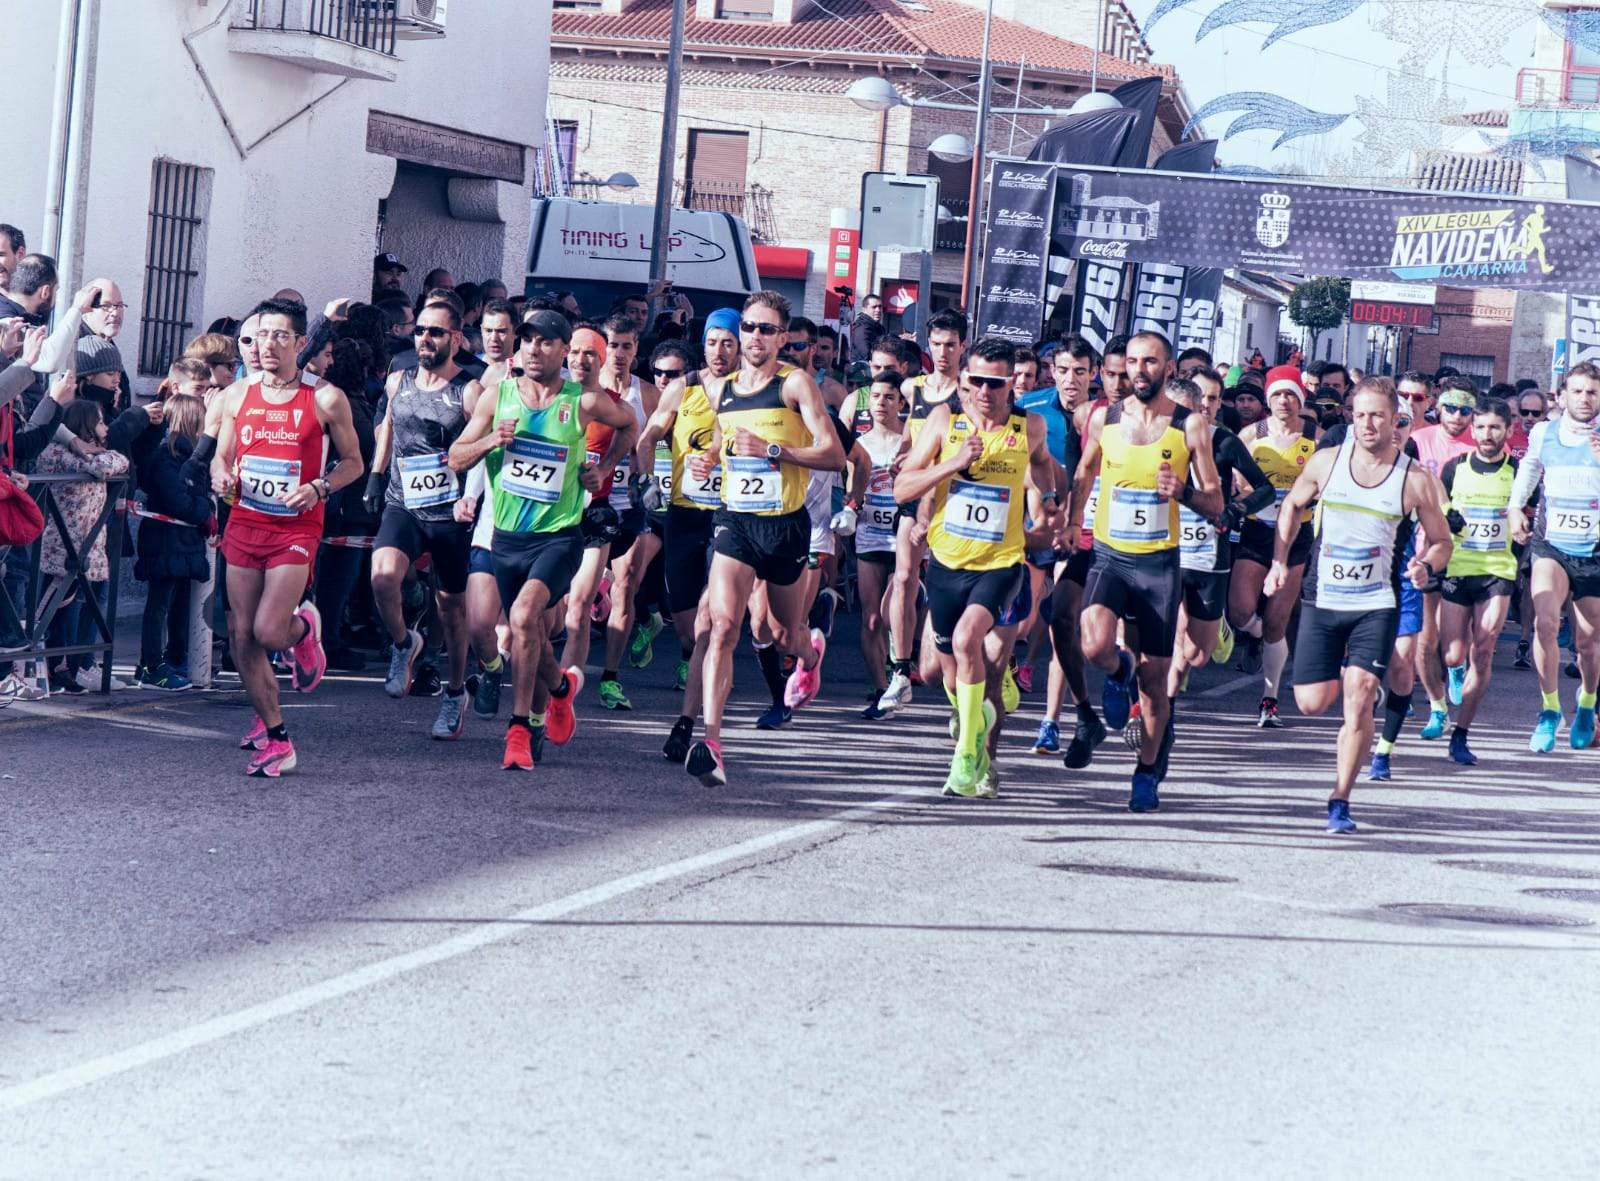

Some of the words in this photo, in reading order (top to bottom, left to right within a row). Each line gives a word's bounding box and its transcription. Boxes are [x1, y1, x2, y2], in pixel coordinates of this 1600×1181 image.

[1402, 216, 1431, 232] XIV
[1435, 213, 1492, 229] LEGUA
[560, 229, 627, 248] TIMING
[640, 233, 682, 252] LP
[1080, 239, 1130, 258] Coca-Cola
[1390, 220, 1527, 267] NAVIDEÑA
[1442, 261, 1528, 277] CAMARMA
[254, 426, 300, 443] alquiber
[511, 459, 557, 484] 547
[250, 477, 290, 498] 703
[410, 472, 450, 491] 402
[740, 478, 766, 495] 22
[966, 503, 990, 523] 10
[1133, 510, 1147, 526] 5
[1557, 513, 1591, 529] 755
[1468, 523, 1501, 538] 739
[1332, 563, 1375, 580] 847
